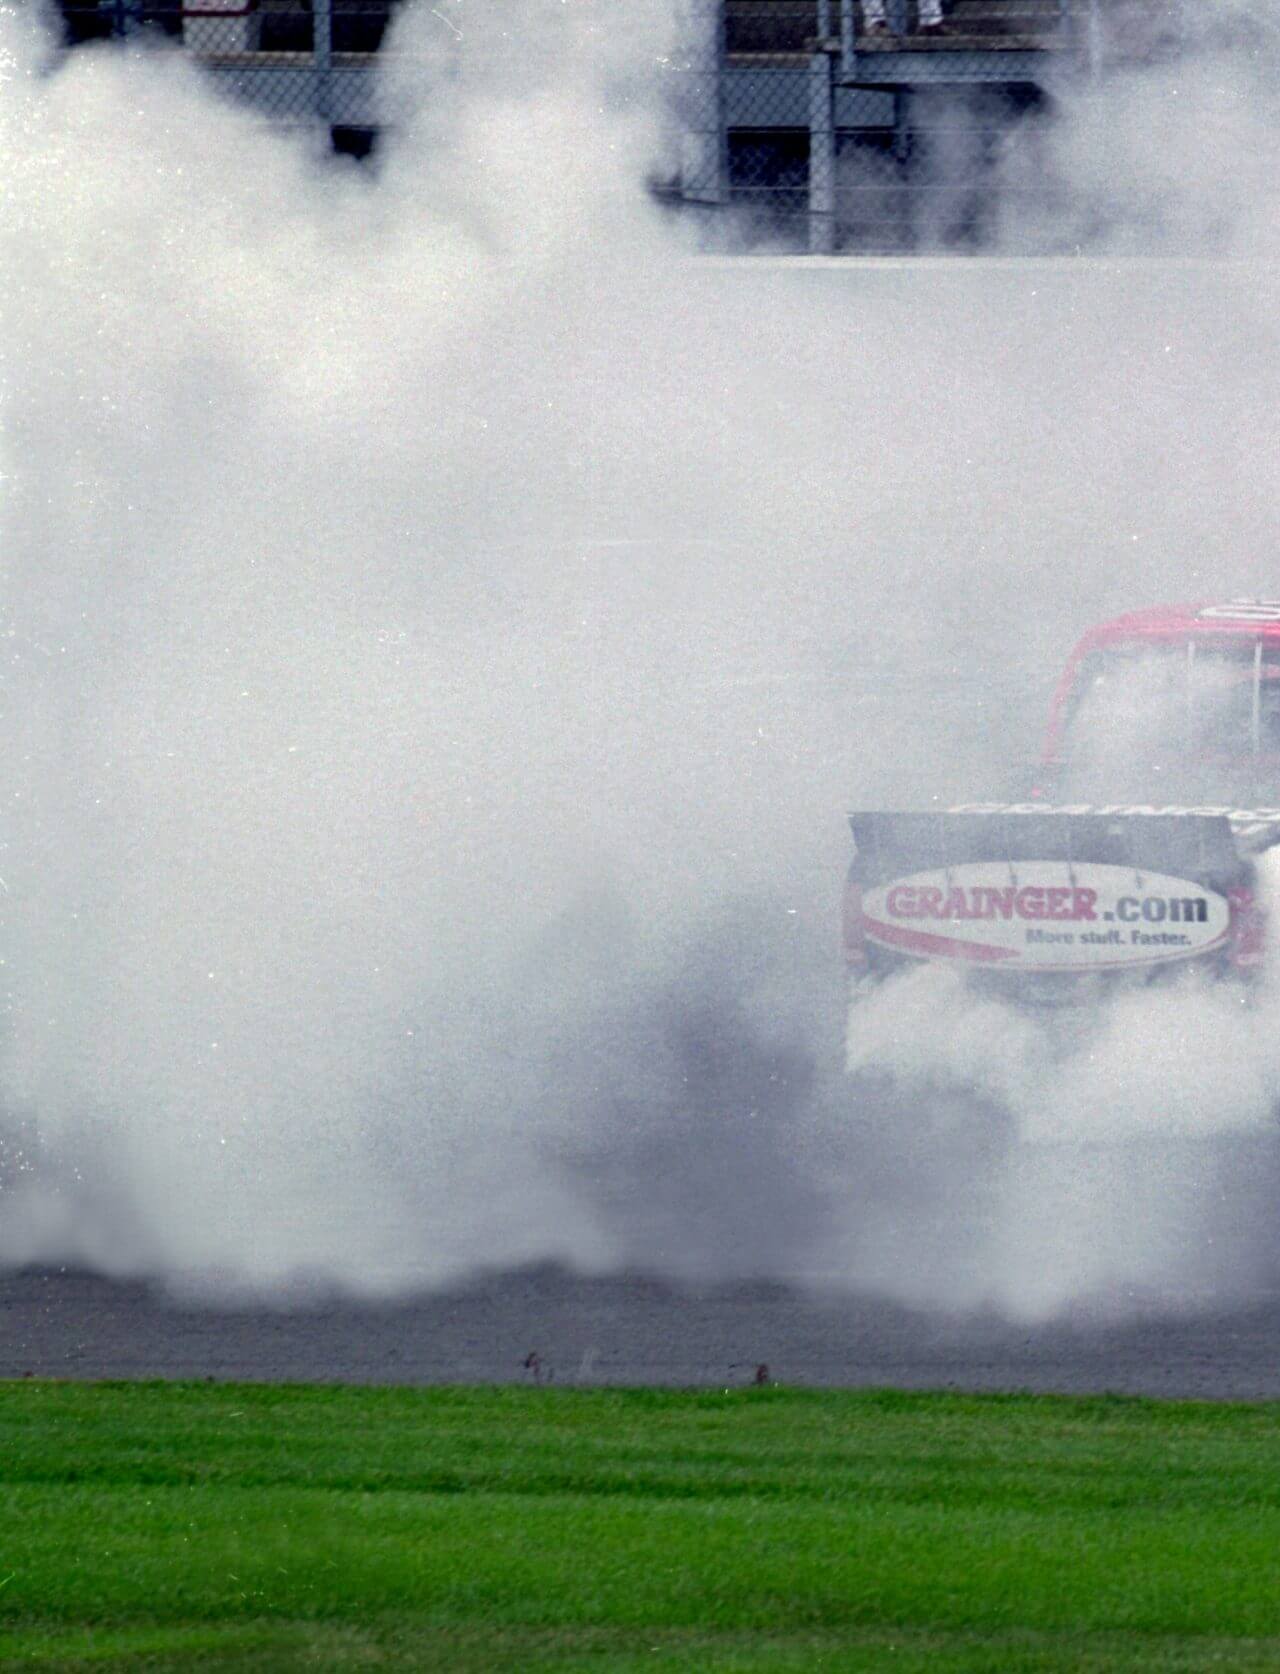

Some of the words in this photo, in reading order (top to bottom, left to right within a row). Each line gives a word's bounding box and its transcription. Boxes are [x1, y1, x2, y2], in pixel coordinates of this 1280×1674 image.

[886, 886, 1208, 922] GRAINGER.com
[1025, 929, 1073, 944] More
[1080, 930, 1126, 944] stuff.
[1131, 930, 1192, 945] Faster.
